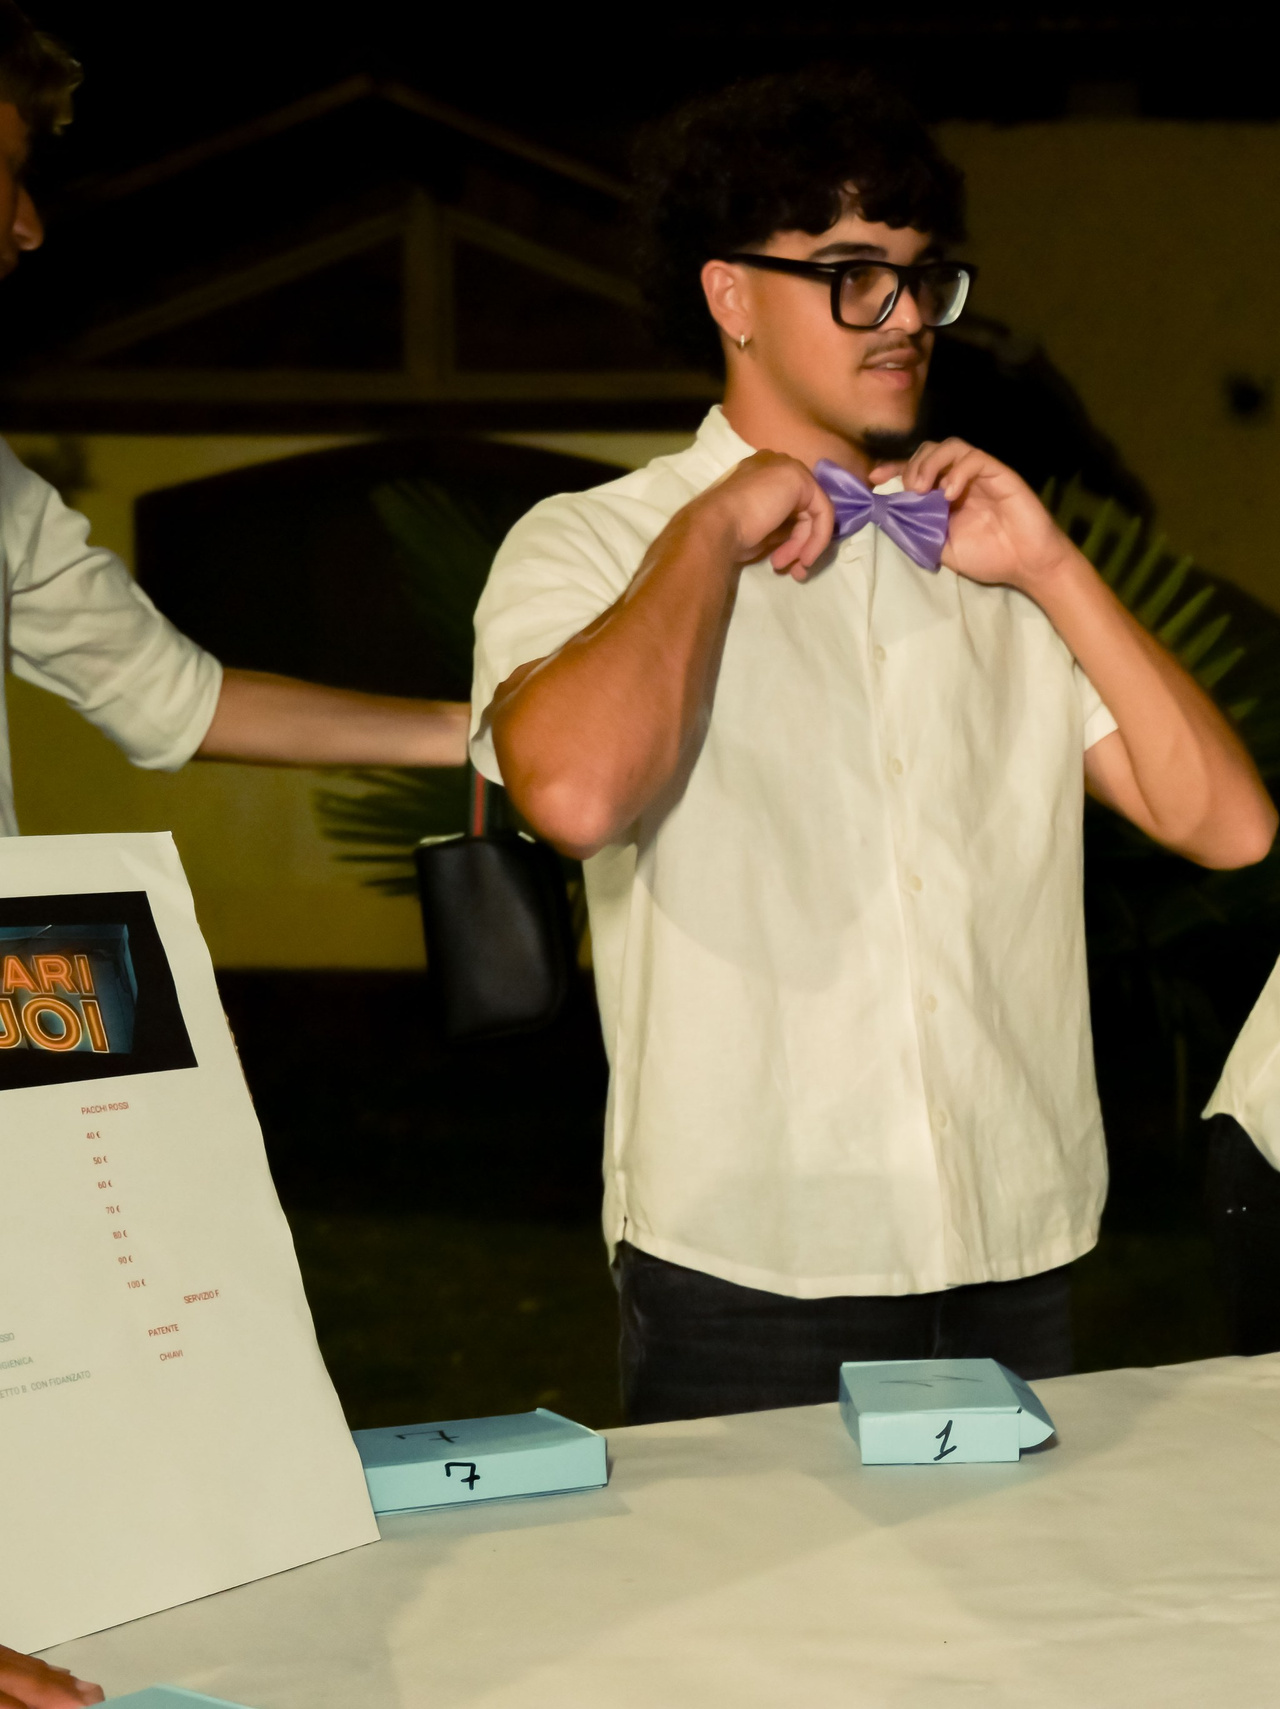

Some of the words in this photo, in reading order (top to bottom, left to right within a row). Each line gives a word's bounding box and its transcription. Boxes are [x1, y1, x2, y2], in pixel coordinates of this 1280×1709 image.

[2, 954, 95, 995] ARI
[81, 1105, 108, 1114] PACCHI
[108, 1102, 129, 1111] ROSSI
[98, 1181, 106, 1189] 60
[106, 1206, 115, 1214] 70
[113, 1231, 122, 1239] 80
[118, 1256, 127, 1264] 90
[127, 1280, 140, 1289] 100
[183, 1291, 214, 1304] SERVIZIO
[148, 1324, 179, 1337] PATENTE
[160, 1350, 183, 1361] CHIAVI
[31, 1381, 48, 1391] CON
[49, 1370, 91, 1386] FIDANZATO
[934, 1419, 958, 1461] 1
[444, 1461, 481, 1491] 7
